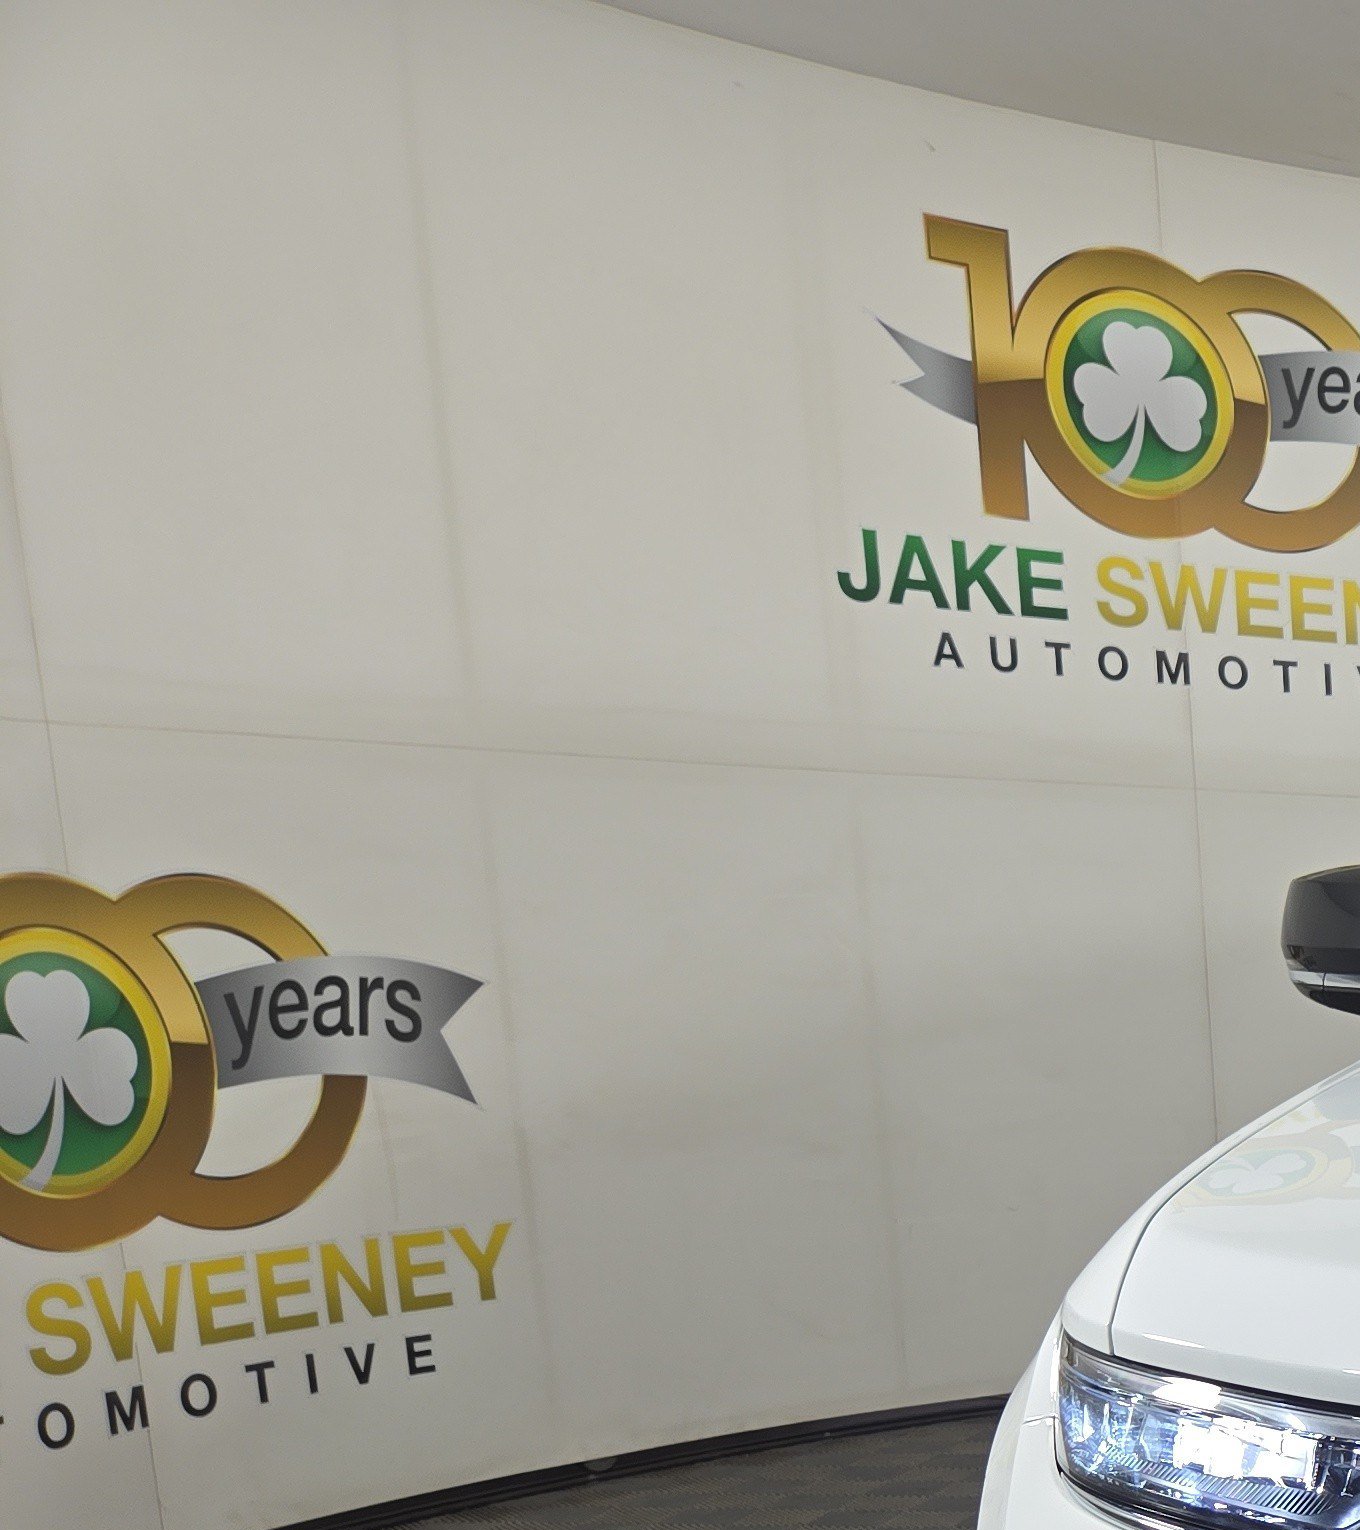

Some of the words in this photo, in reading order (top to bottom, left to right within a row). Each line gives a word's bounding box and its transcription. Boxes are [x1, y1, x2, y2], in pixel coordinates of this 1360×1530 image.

[837, 528, 1069, 621] JAKE
[223, 974, 423, 1070] years
[25, 1222, 512, 1376] SWEENEY
[0, 1333, 437, 1450] OMOTIVE
